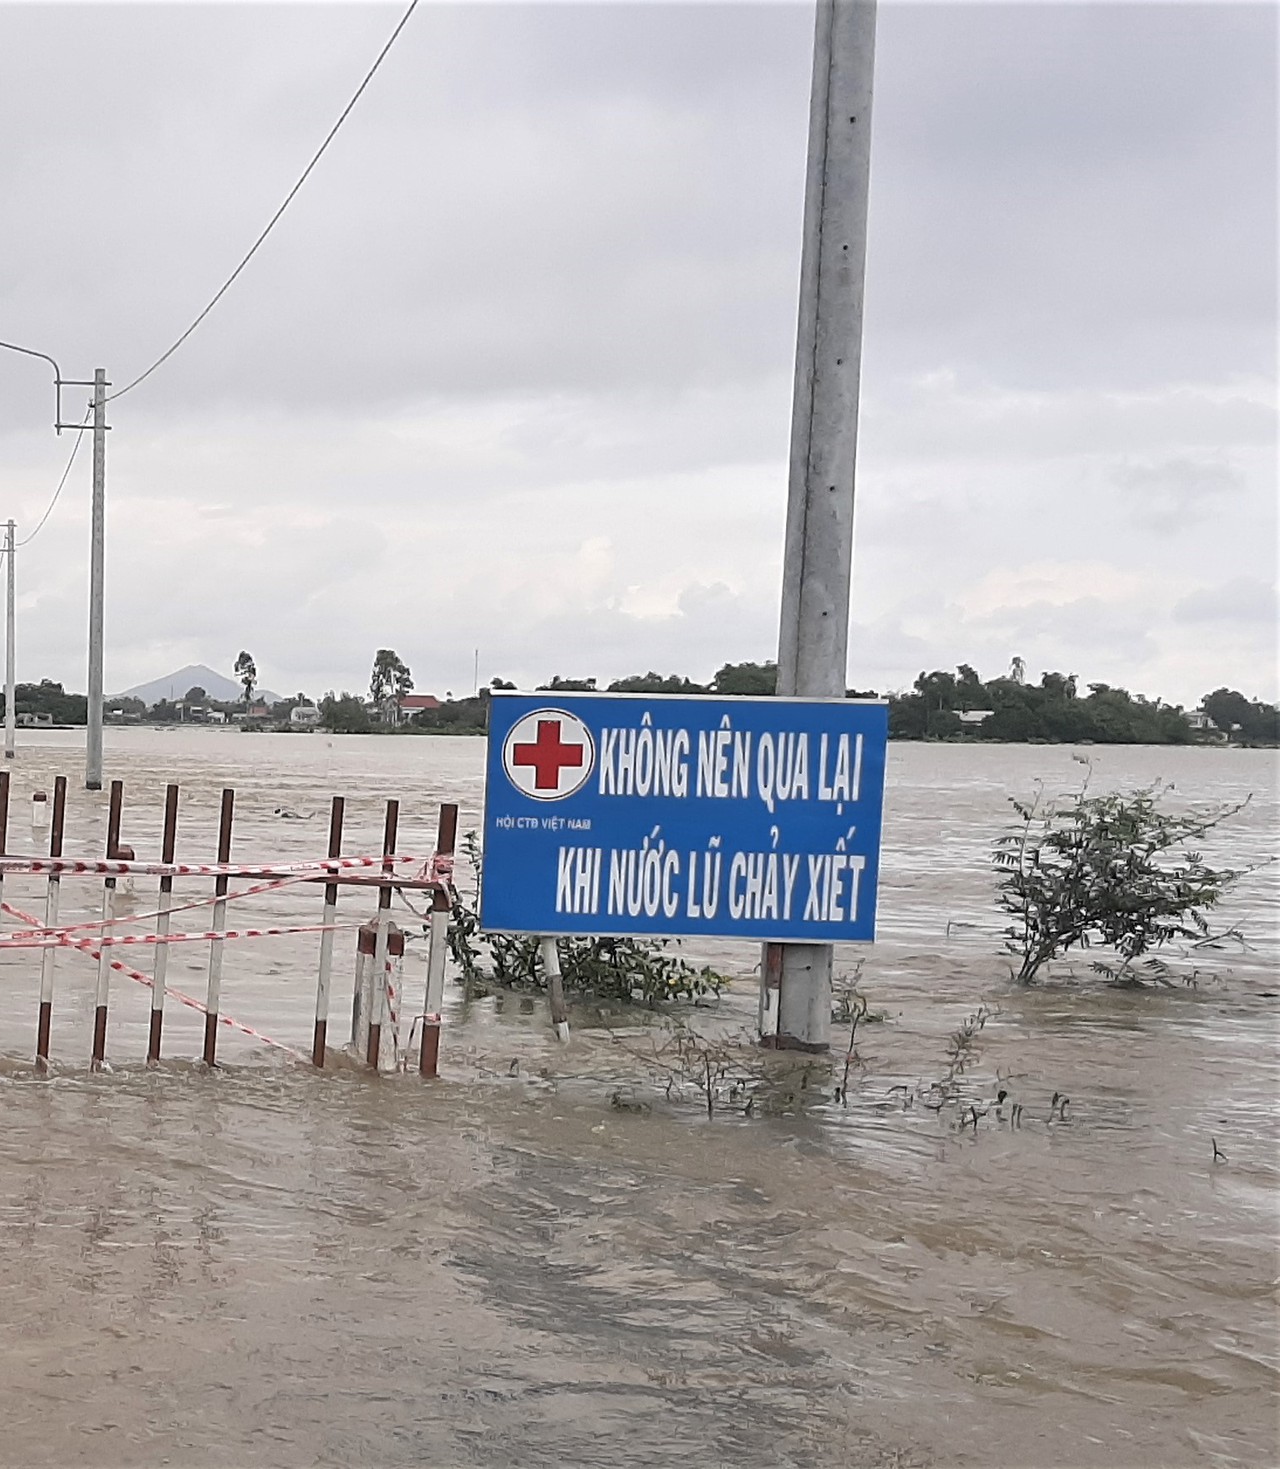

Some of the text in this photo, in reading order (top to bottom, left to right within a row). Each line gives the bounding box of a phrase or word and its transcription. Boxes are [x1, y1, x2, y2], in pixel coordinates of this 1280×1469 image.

[598, 711, 863, 815] KHÔNG NÊN QUA LẠI
[496, 814, 591, 832] HỘI CTĐ VIỆT NAM
[555, 825, 865, 922] KHI NƯỚC LŨ CHẢY XIẾT
